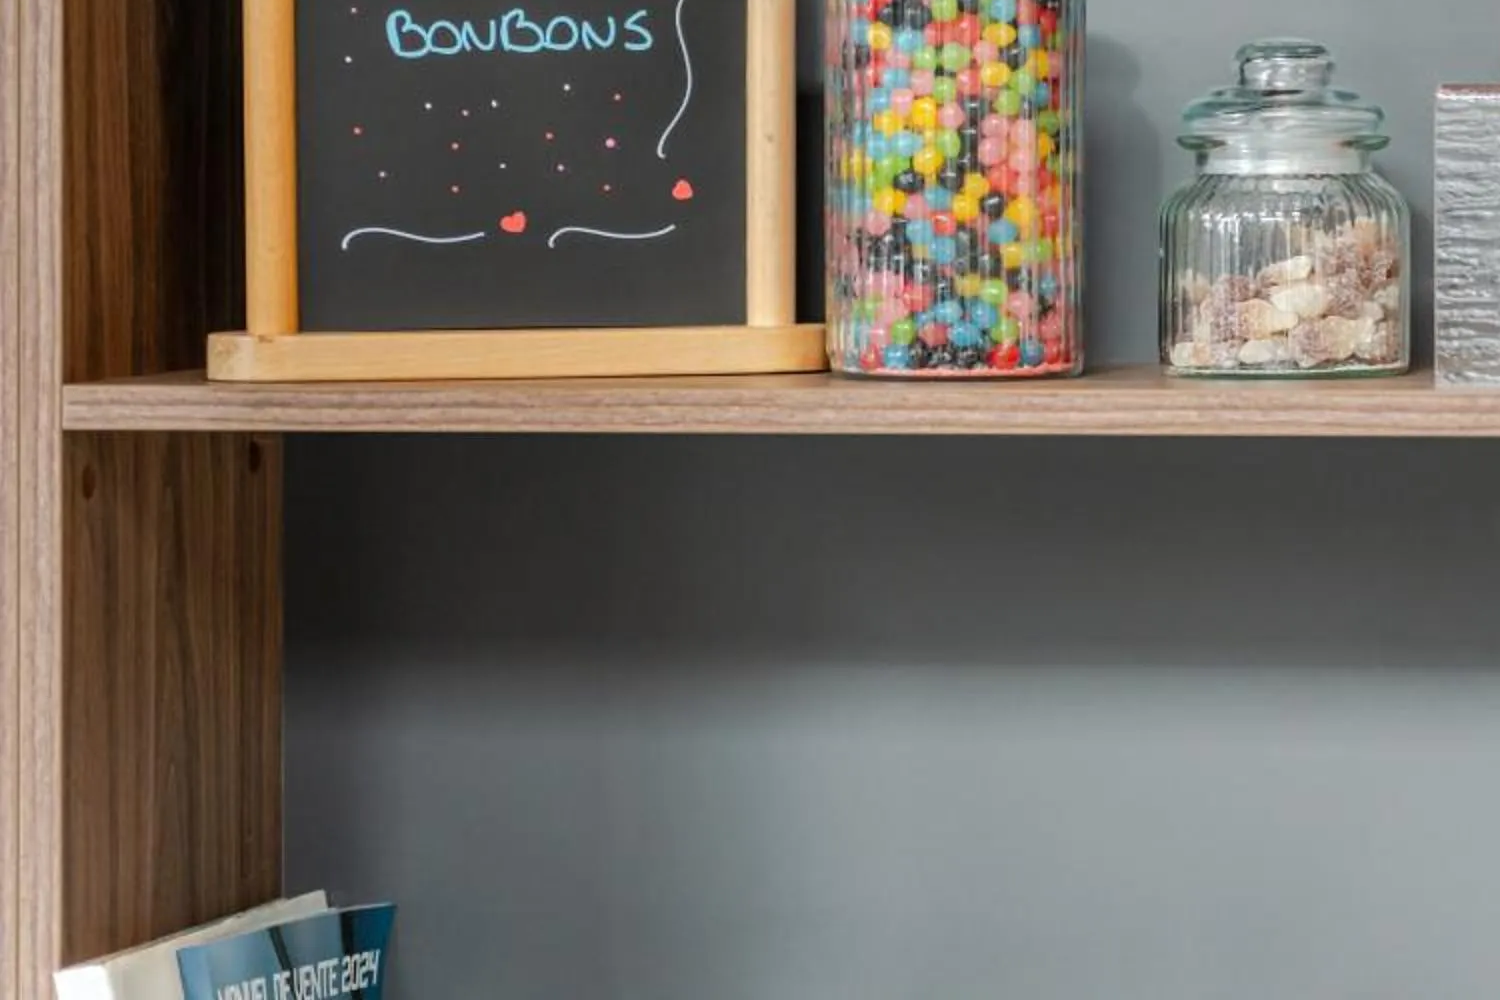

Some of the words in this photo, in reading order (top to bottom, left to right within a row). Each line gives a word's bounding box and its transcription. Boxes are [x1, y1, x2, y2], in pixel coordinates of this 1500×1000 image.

[386, 8, 655, 58] BONBONS
[294, 958, 340, 1000] VENTE
[341, 949, 381, 993] 2024
